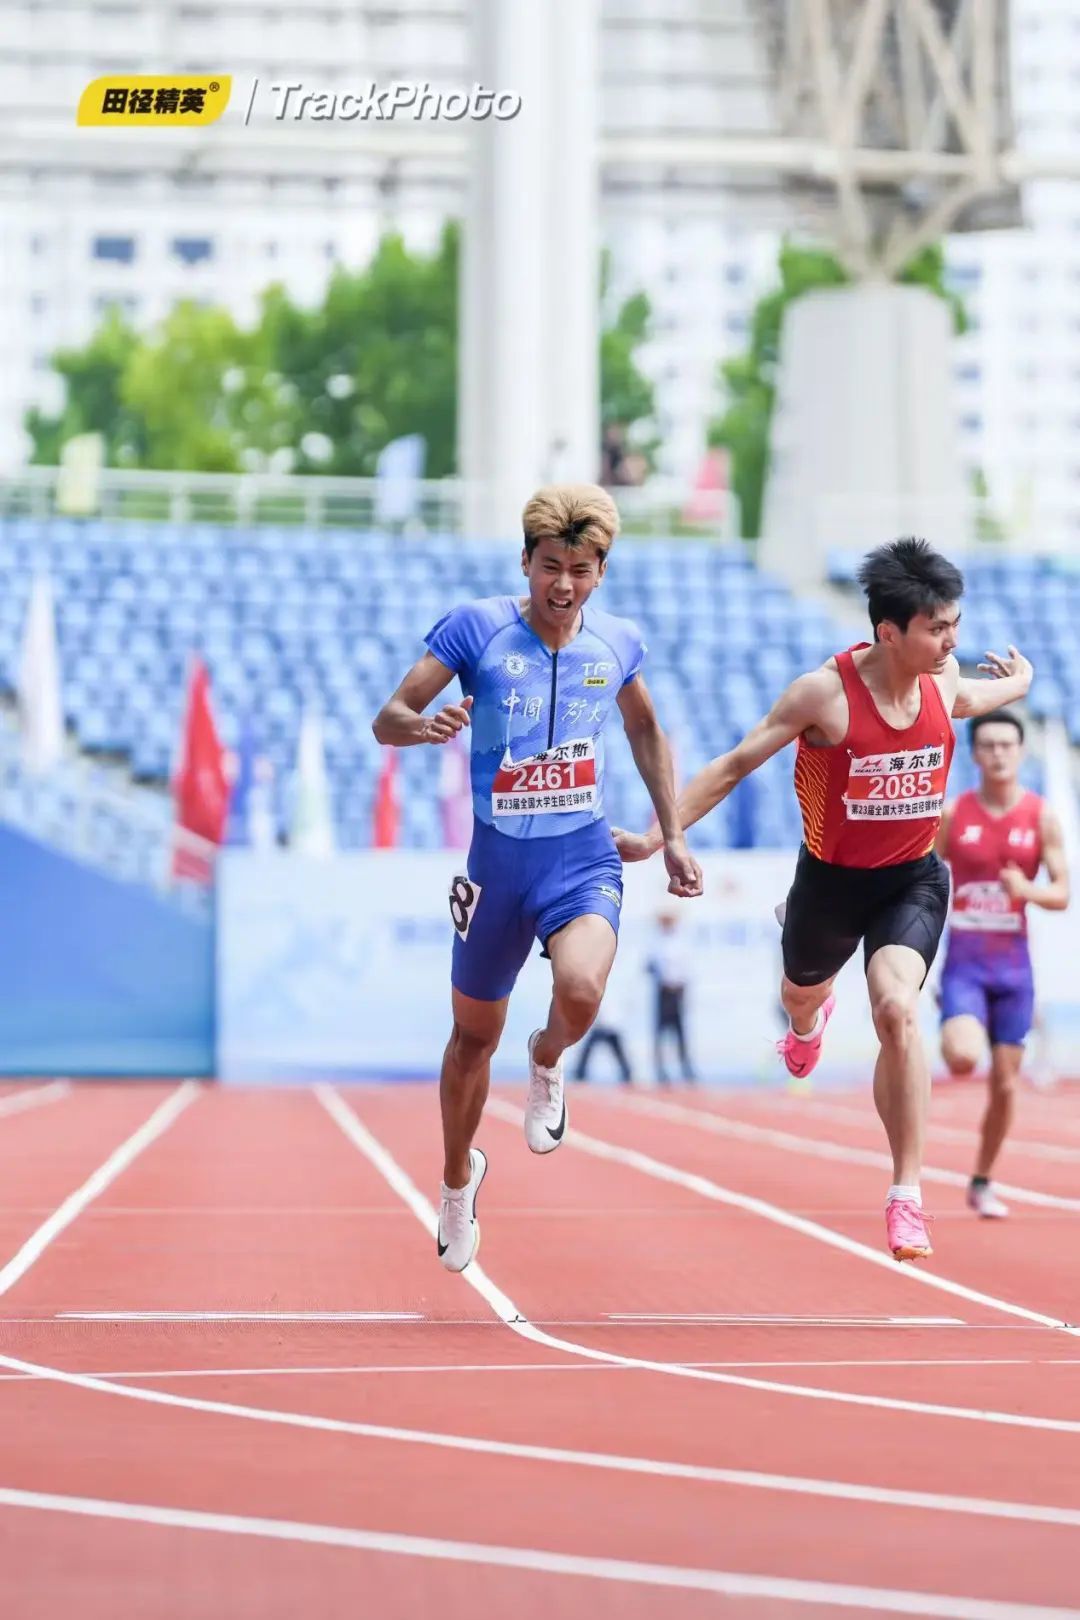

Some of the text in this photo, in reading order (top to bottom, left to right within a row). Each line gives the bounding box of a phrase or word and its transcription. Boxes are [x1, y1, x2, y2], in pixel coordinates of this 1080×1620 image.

[889, 752, 941, 772] 海尔斯
[511, 762, 576, 791] 2461
[868, 772, 932, 799] 2085
[448, 875, 475, 933] 8
